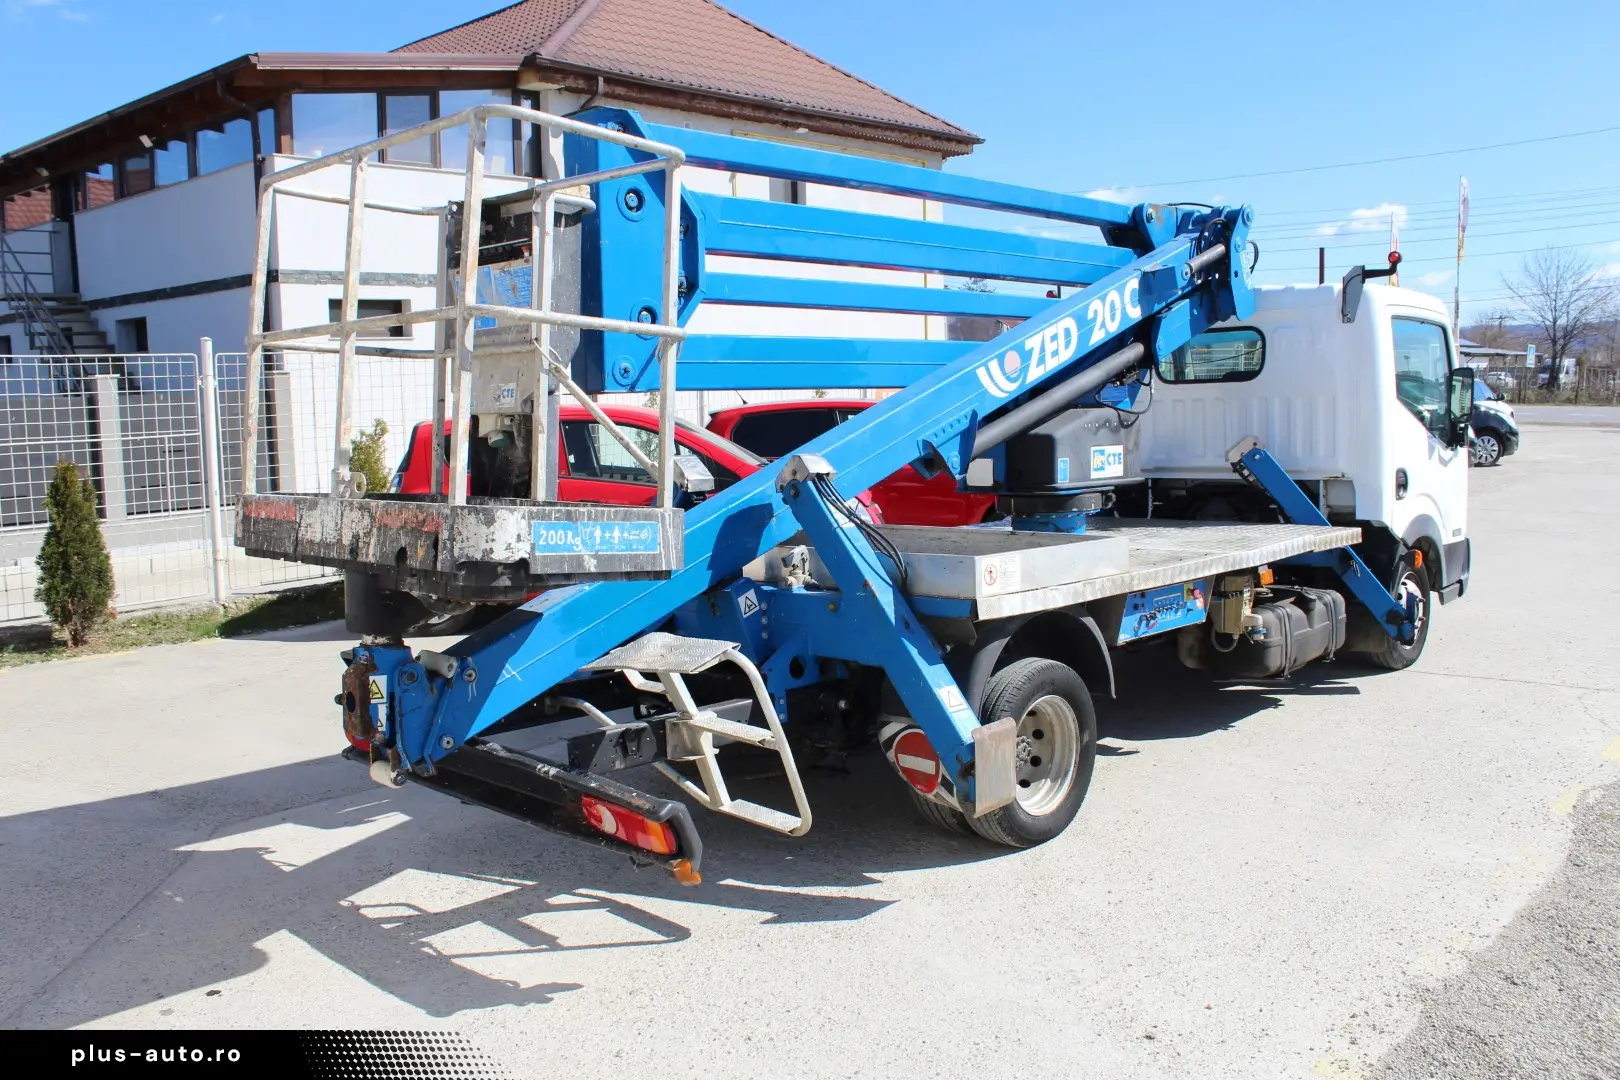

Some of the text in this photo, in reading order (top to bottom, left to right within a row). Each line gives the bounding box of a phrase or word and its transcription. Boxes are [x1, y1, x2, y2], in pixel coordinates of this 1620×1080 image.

[1024, 316, 1078, 385] ZED
[1087, 290, 1122, 347] 20
[1106, 452, 1123, 466] CTE
